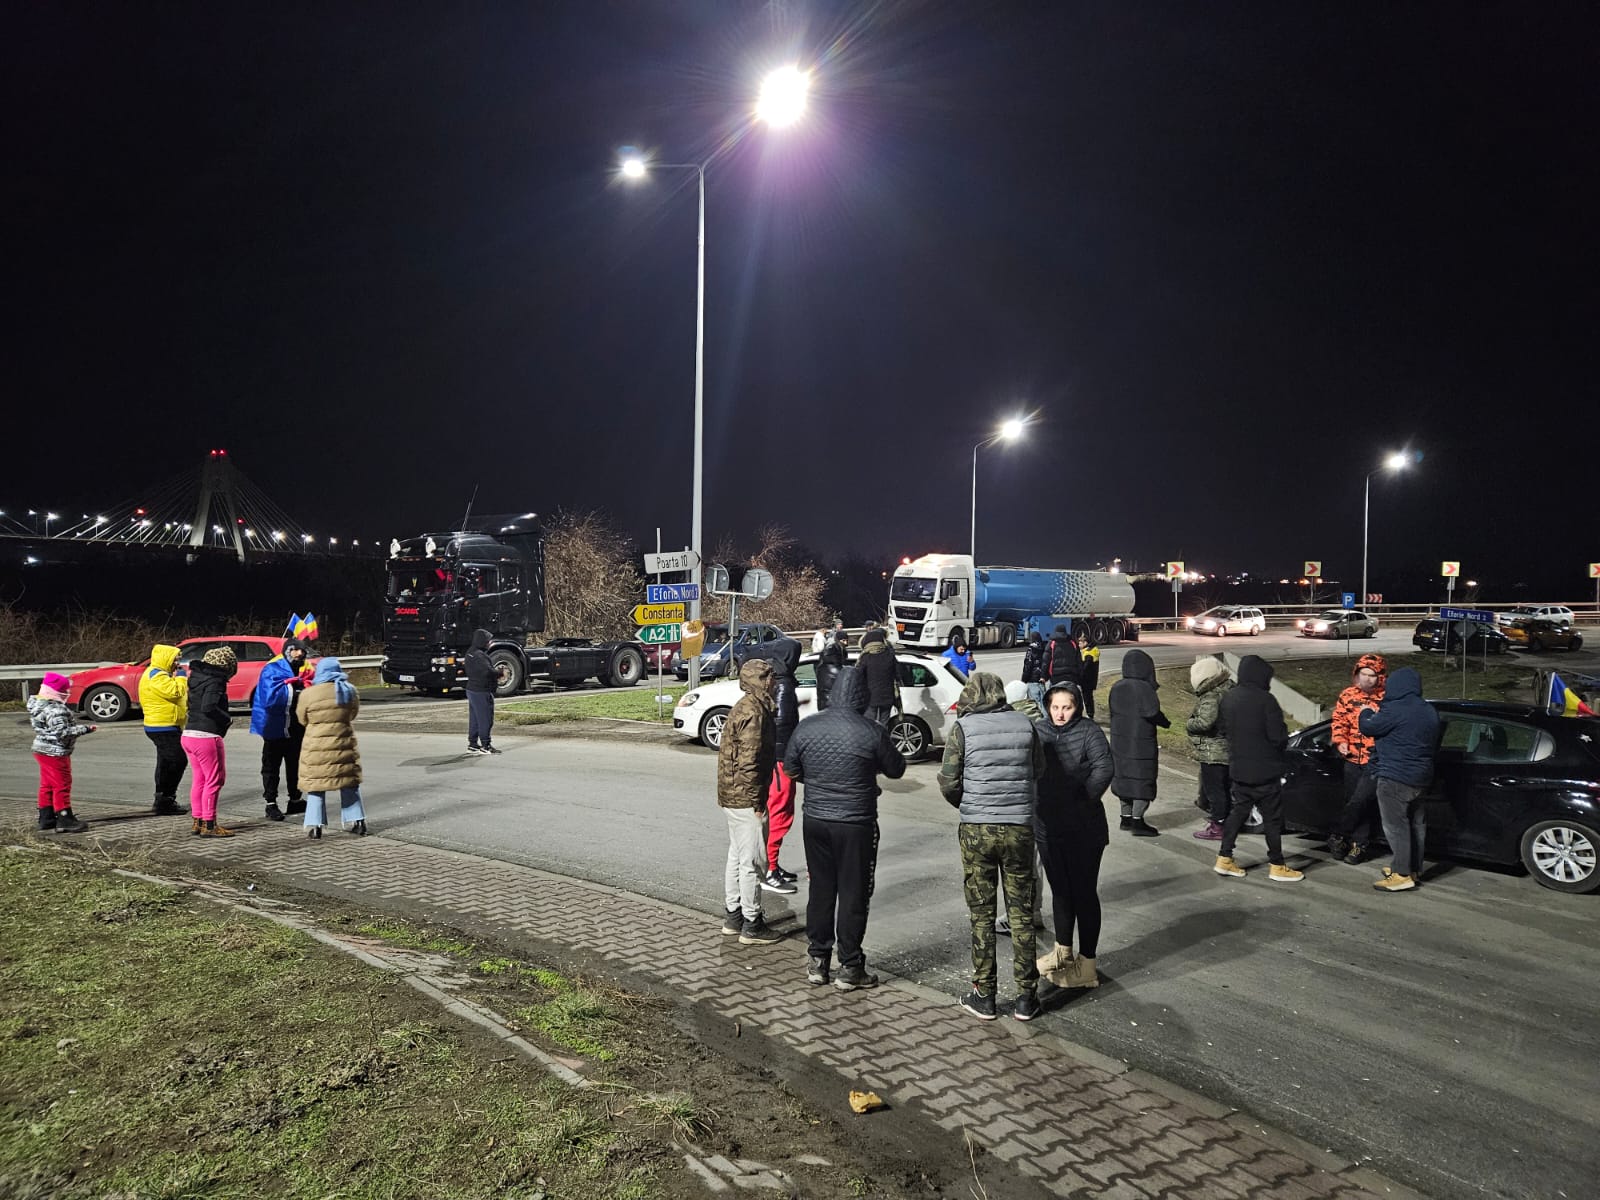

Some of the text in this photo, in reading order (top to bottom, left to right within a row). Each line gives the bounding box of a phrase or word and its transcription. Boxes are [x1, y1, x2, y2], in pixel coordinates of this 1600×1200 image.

[656, 554, 688, 569] Poarta 10
[653, 587, 679, 600] Eforie
[681, 586, 694, 599] Nord
[649, 627, 666, 642] A2
